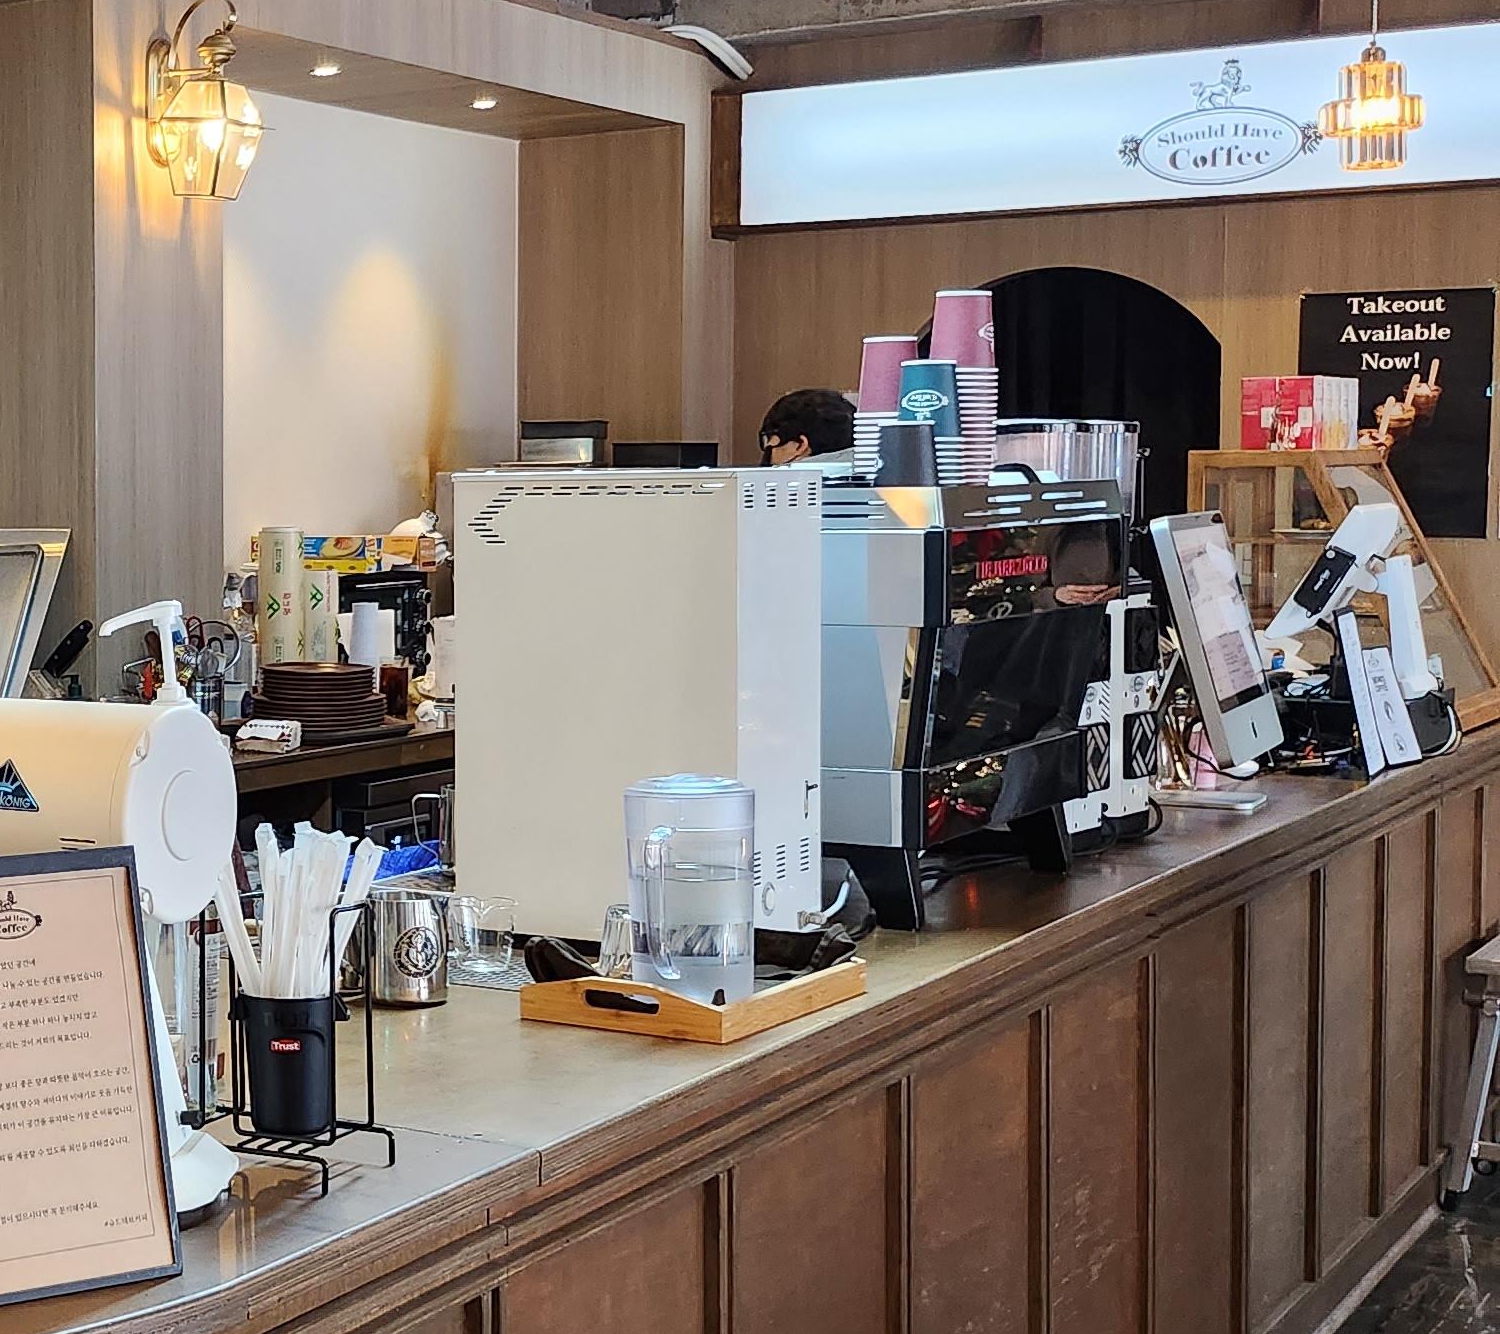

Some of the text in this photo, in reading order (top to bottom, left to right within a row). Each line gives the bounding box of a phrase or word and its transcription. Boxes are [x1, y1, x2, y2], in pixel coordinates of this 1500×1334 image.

[1157, 123, 1283, 148] Should Have
[1169, 145, 1270, 171] Coffee
[1347, 296, 1446, 315] Takeout
[1340, 323, 1451, 343] Available
[1361, 352, 1420, 370] Now!
[271, 1040, 300, 1051] Trust
